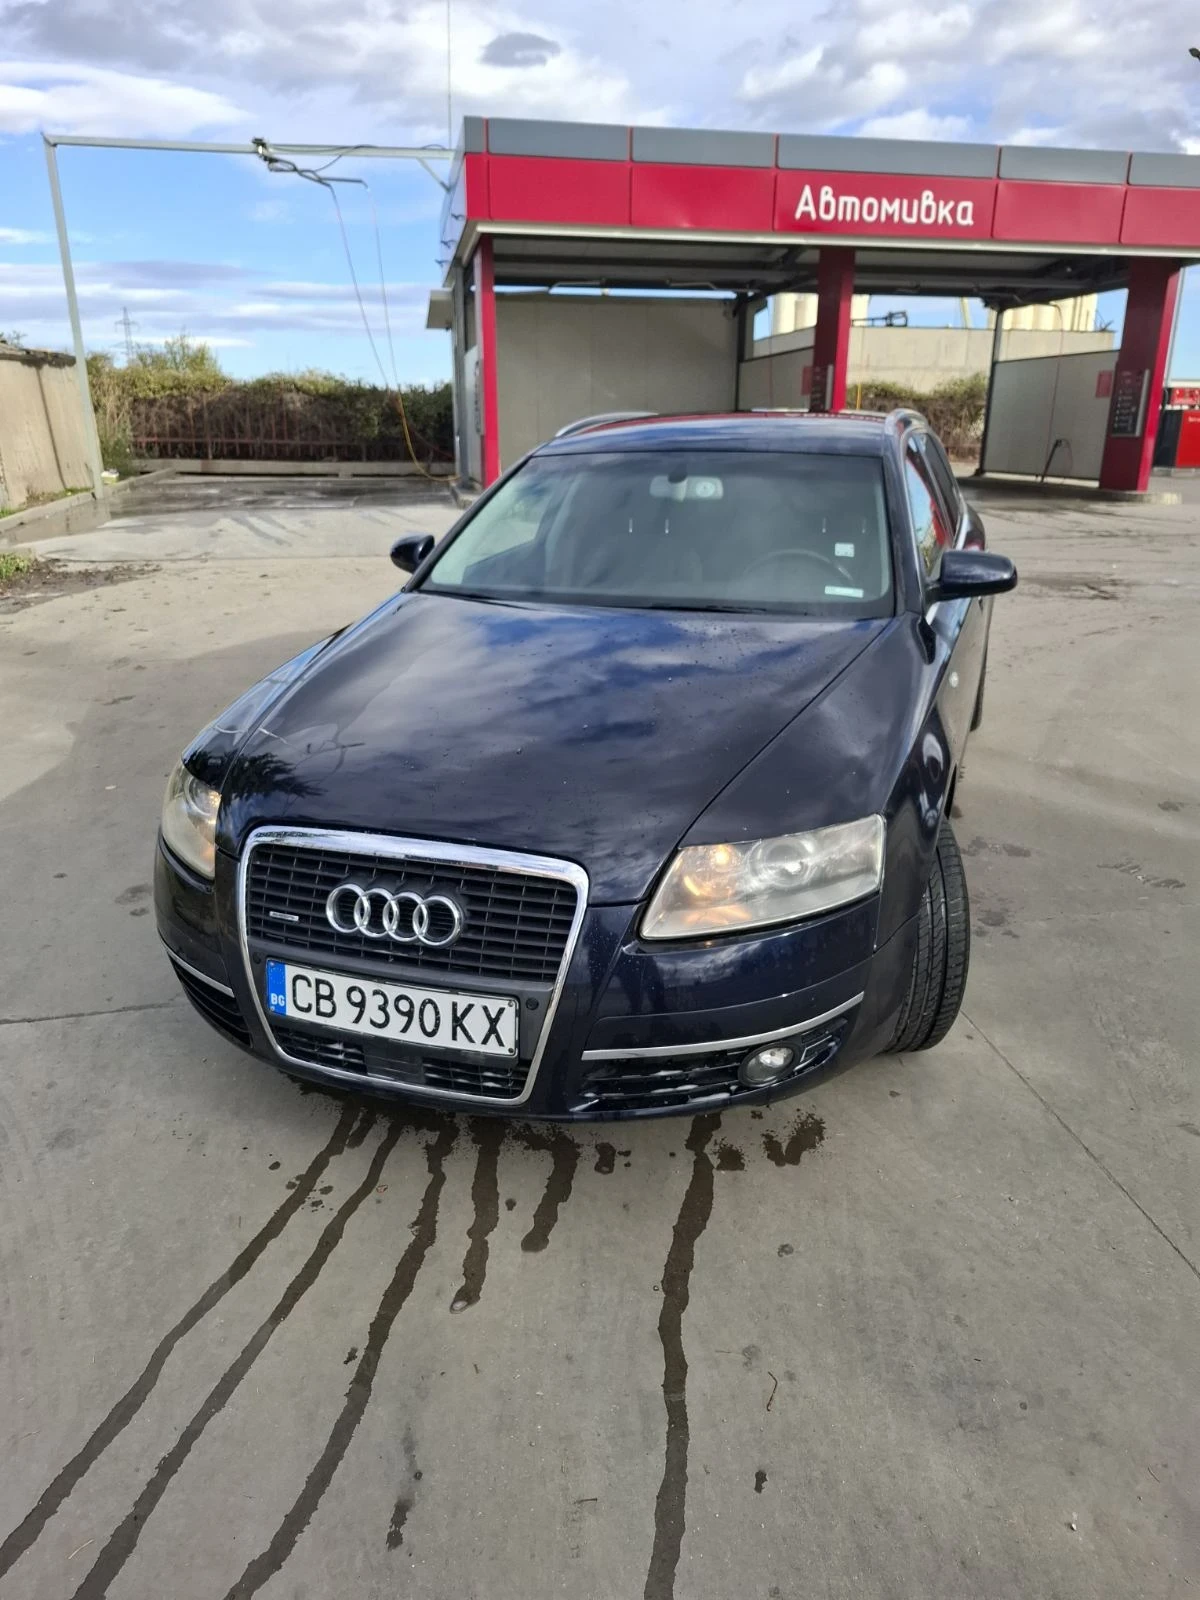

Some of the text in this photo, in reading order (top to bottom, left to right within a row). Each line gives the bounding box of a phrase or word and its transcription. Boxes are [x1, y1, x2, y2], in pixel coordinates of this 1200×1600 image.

[794, 184, 975, 226] Автомивка
[270, 993, 285, 1007] BG
[292, 974, 506, 1048] CB 9390 KX
